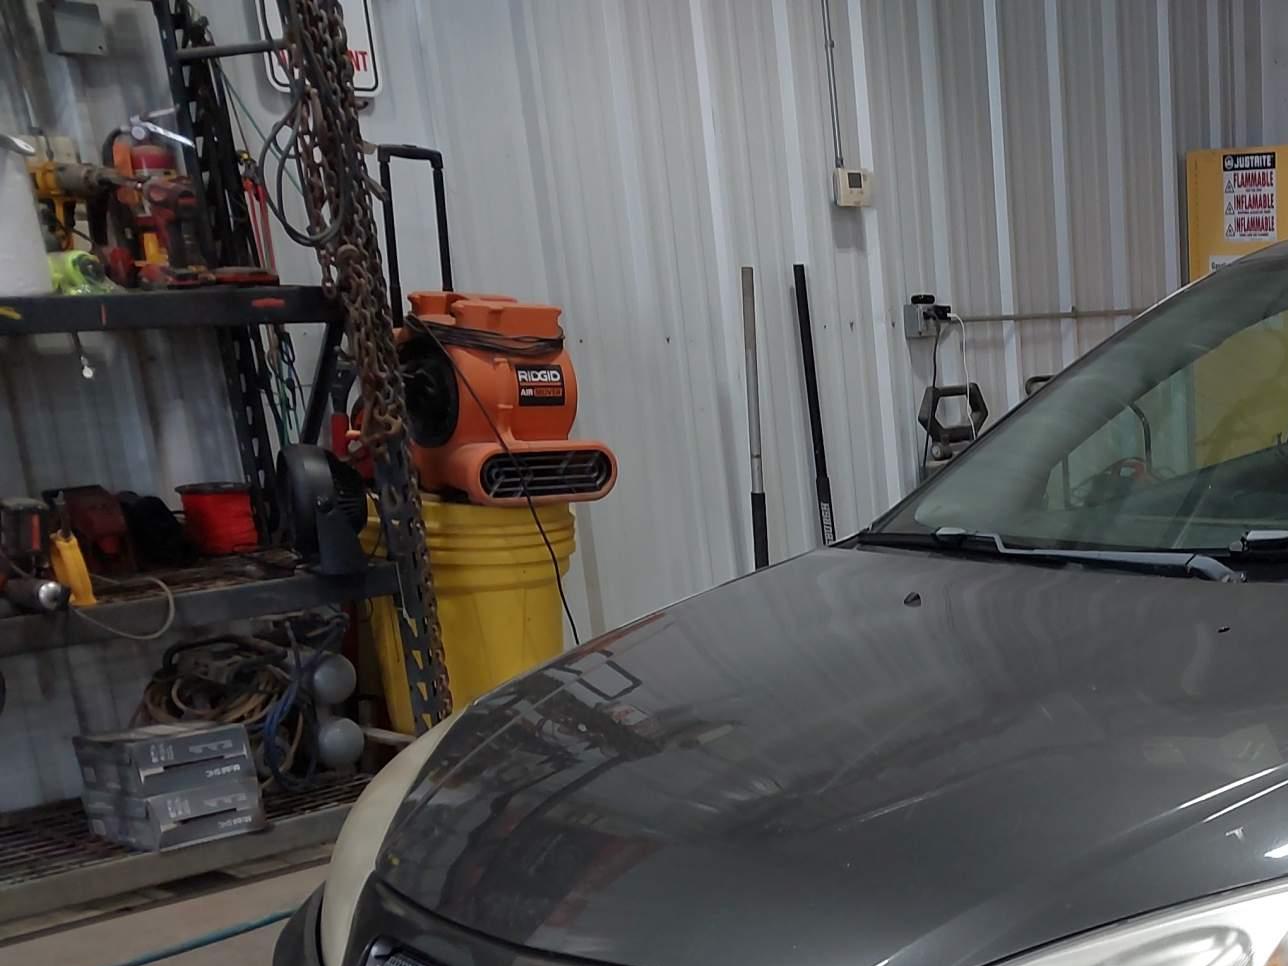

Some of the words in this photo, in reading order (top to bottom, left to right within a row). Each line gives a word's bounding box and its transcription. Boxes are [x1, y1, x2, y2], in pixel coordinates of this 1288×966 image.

[1233, 154, 1272, 168] JUSTRITE
[1233, 171, 1273, 188] FLAMMABLE
[1233, 193, 1274, 210] INFLAMABLE
[1234, 215, 1274, 232] INFLAMMABLE
[517, 370, 561, 382] RIDGID
